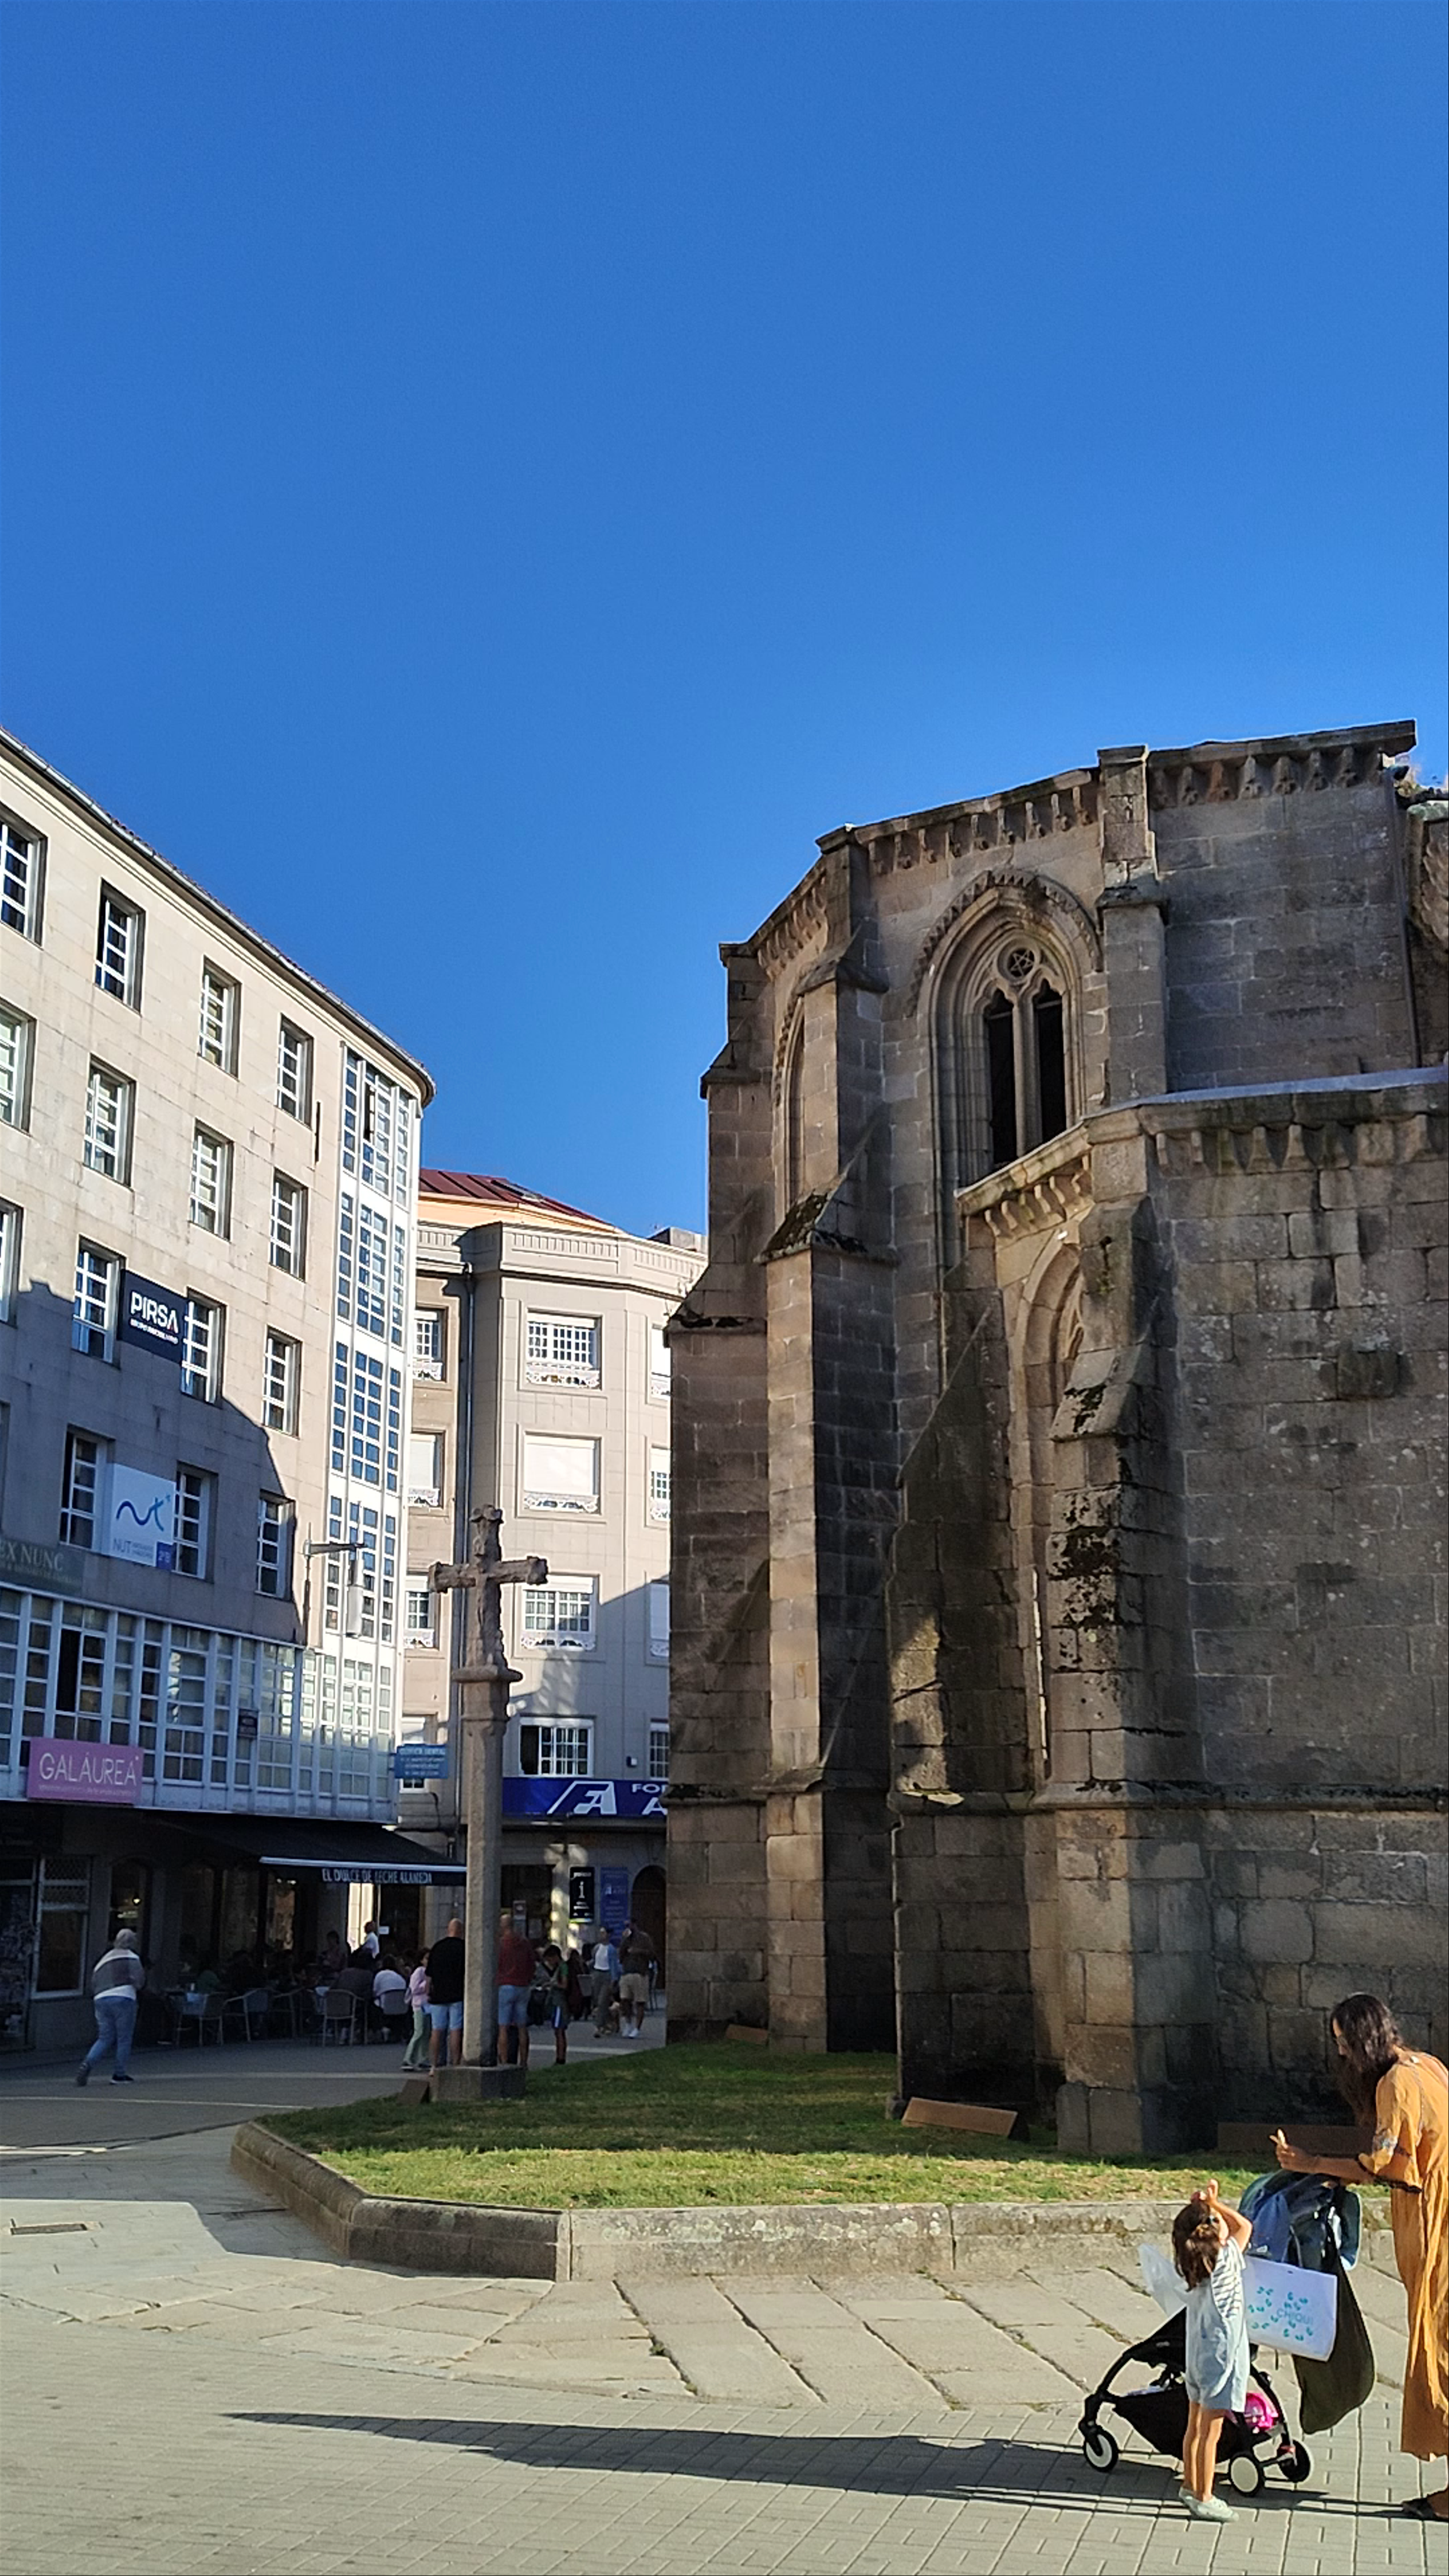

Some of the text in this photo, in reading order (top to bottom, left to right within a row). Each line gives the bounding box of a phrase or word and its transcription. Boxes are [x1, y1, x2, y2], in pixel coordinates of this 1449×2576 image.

[131, 1291, 178, 1333] PIRSA
[20, 1544, 64, 1572] NUNC
[40, 1752, 137, 1786] GALÁUREA
[322, 1868, 332, 1881] EL
[334, 1869, 360, 1882] DULCE
[361, 1870, 372, 1882] DE
[375, 1870, 398, 1883] LECHE
